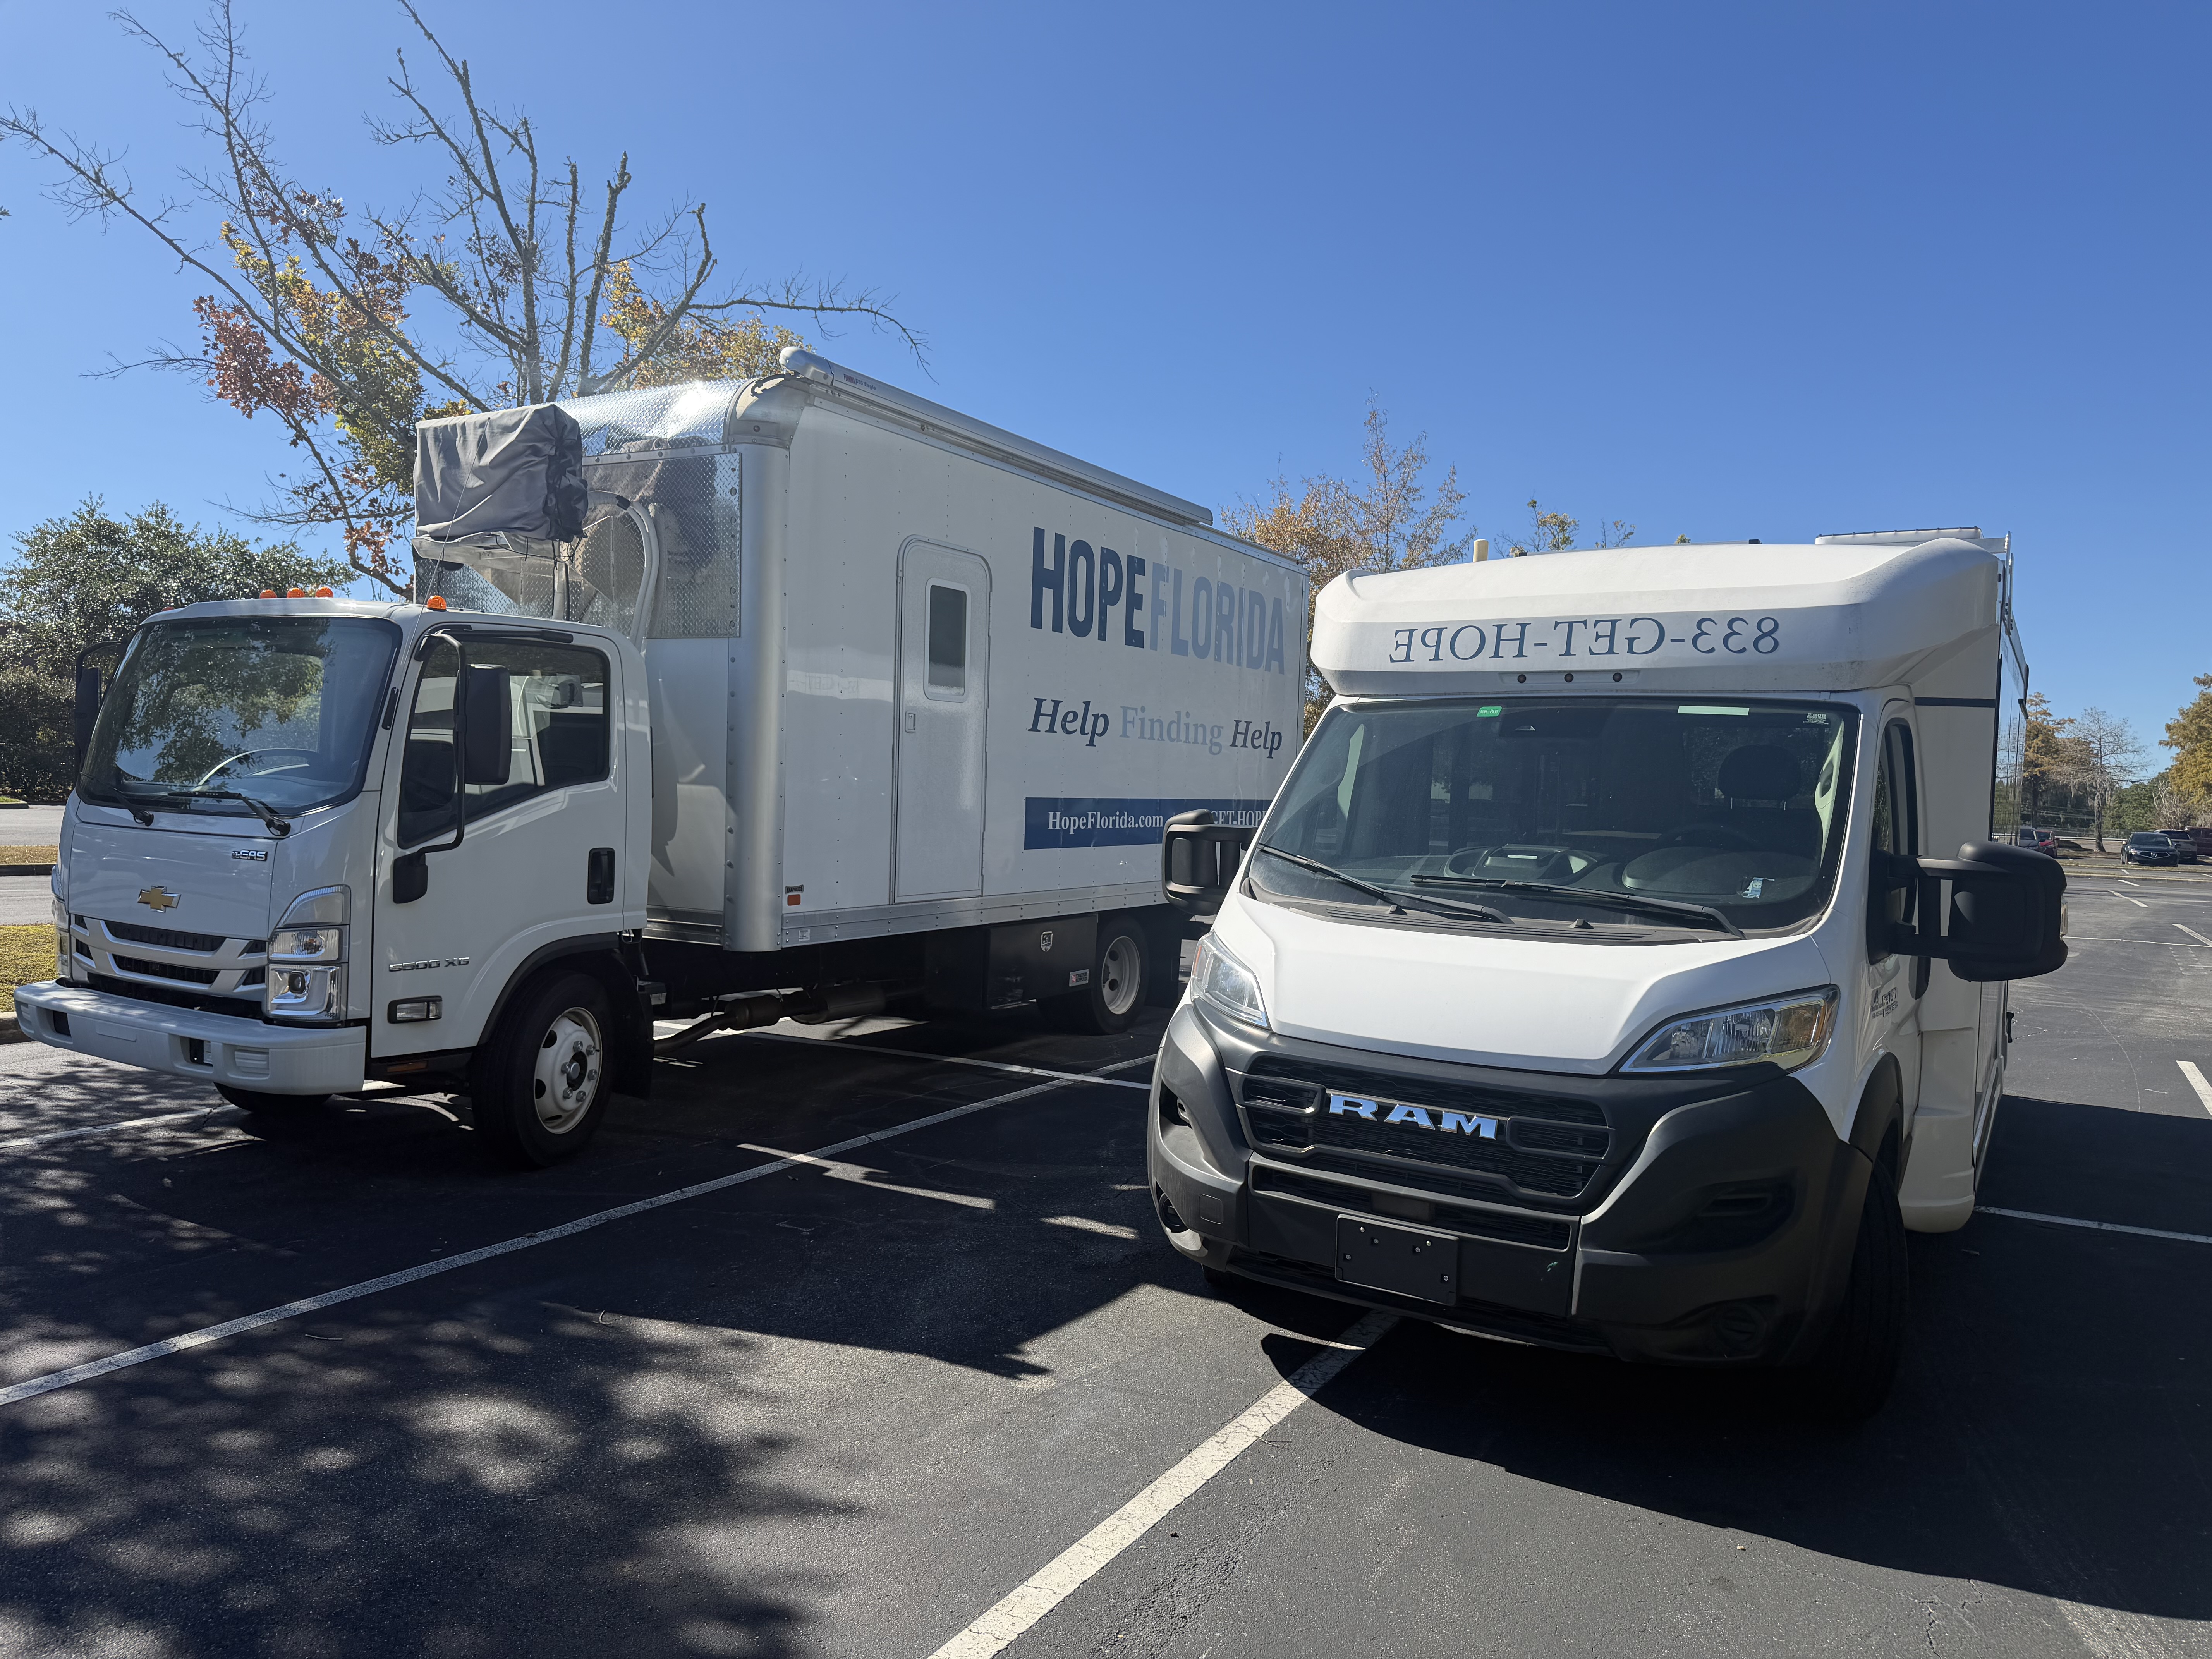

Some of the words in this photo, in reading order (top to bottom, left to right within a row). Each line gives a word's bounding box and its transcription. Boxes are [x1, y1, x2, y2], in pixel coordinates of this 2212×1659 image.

[1027, 697, 1110, 747] Help
[1119, 705, 1224, 755] Finding
[1229, 720, 1283, 759] Help
[1047, 811, 1164, 835] HopeFlorida.com
[389, 959, 440, 972] 5500
[444, 957, 470, 967] XG
[1329, 1093, 1499, 1140] RAM
